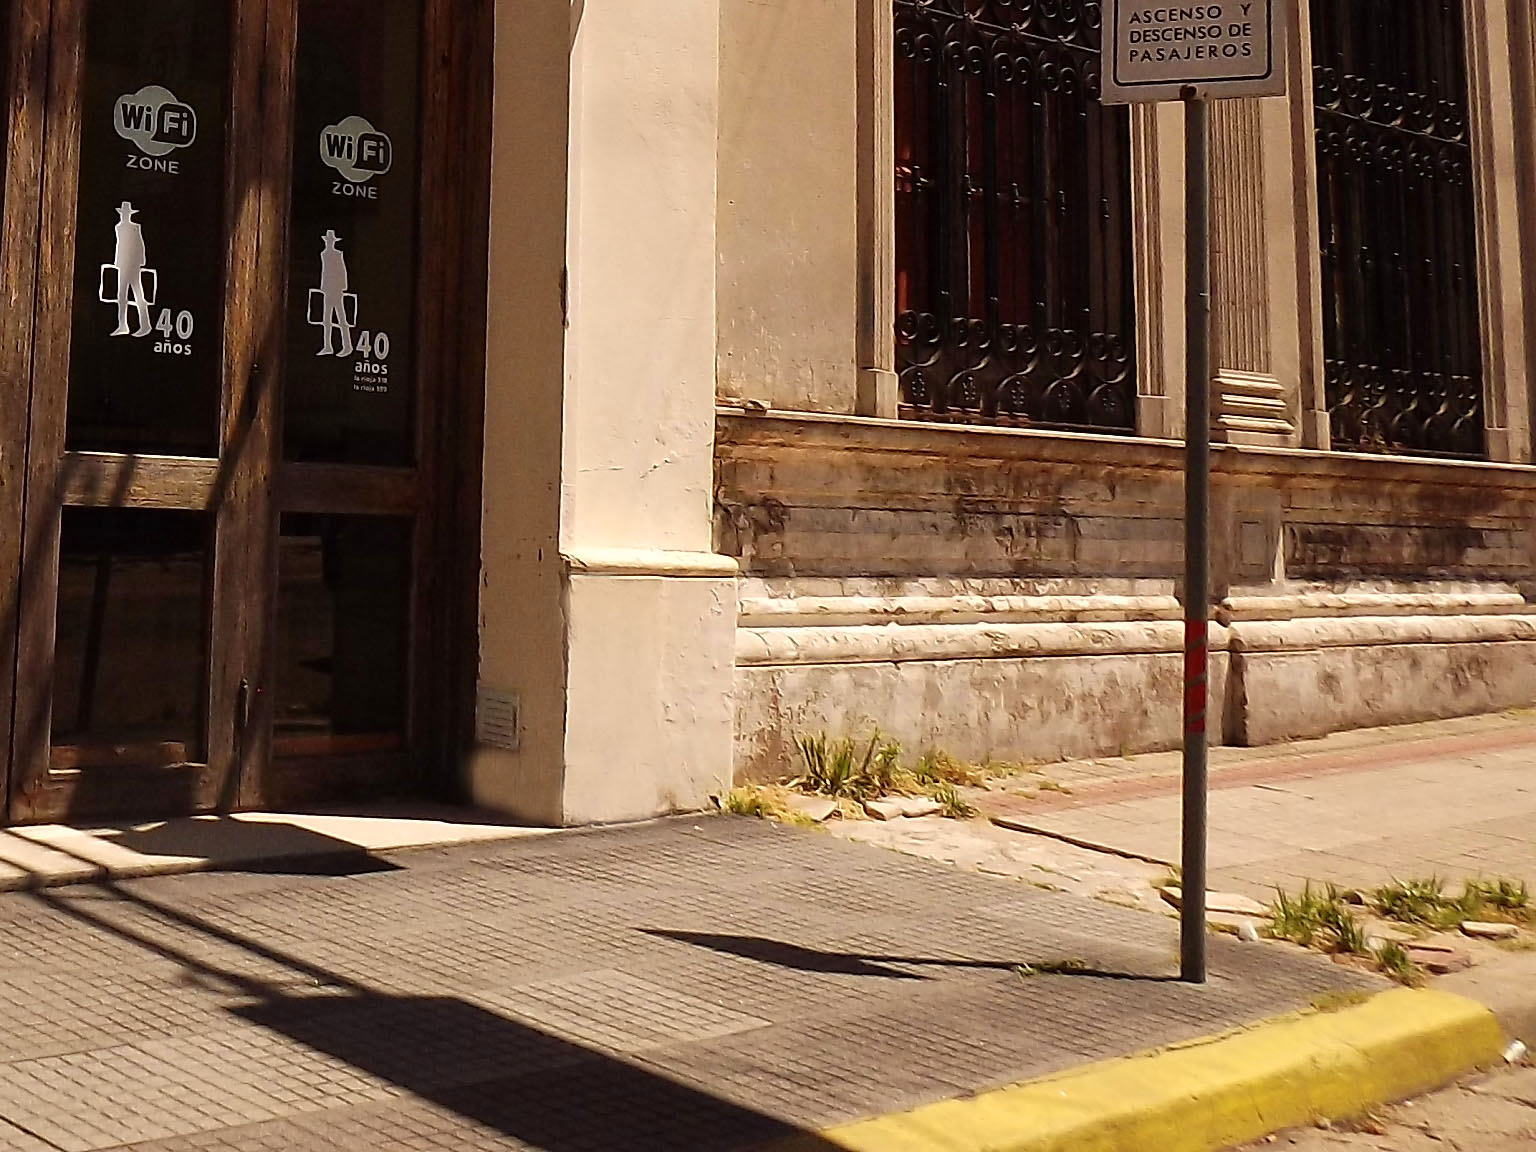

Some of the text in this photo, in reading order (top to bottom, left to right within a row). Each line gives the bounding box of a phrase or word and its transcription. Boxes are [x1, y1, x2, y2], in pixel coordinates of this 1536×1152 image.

[1129, 3, 1251, 25] ASCENSO Y
[1129, 23, 1252, 44] DESCENSO DE
[1129, 43, 1252, 63] PASAJEROS
[126, 154, 180, 175] ZONE
[331, 181, 378, 199] ZONE
[155, 308, 194, 339] 40
[154, 339, 192, 356] años
[355, 330, 390, 360] 40
[354, 359, 388, 375] años
